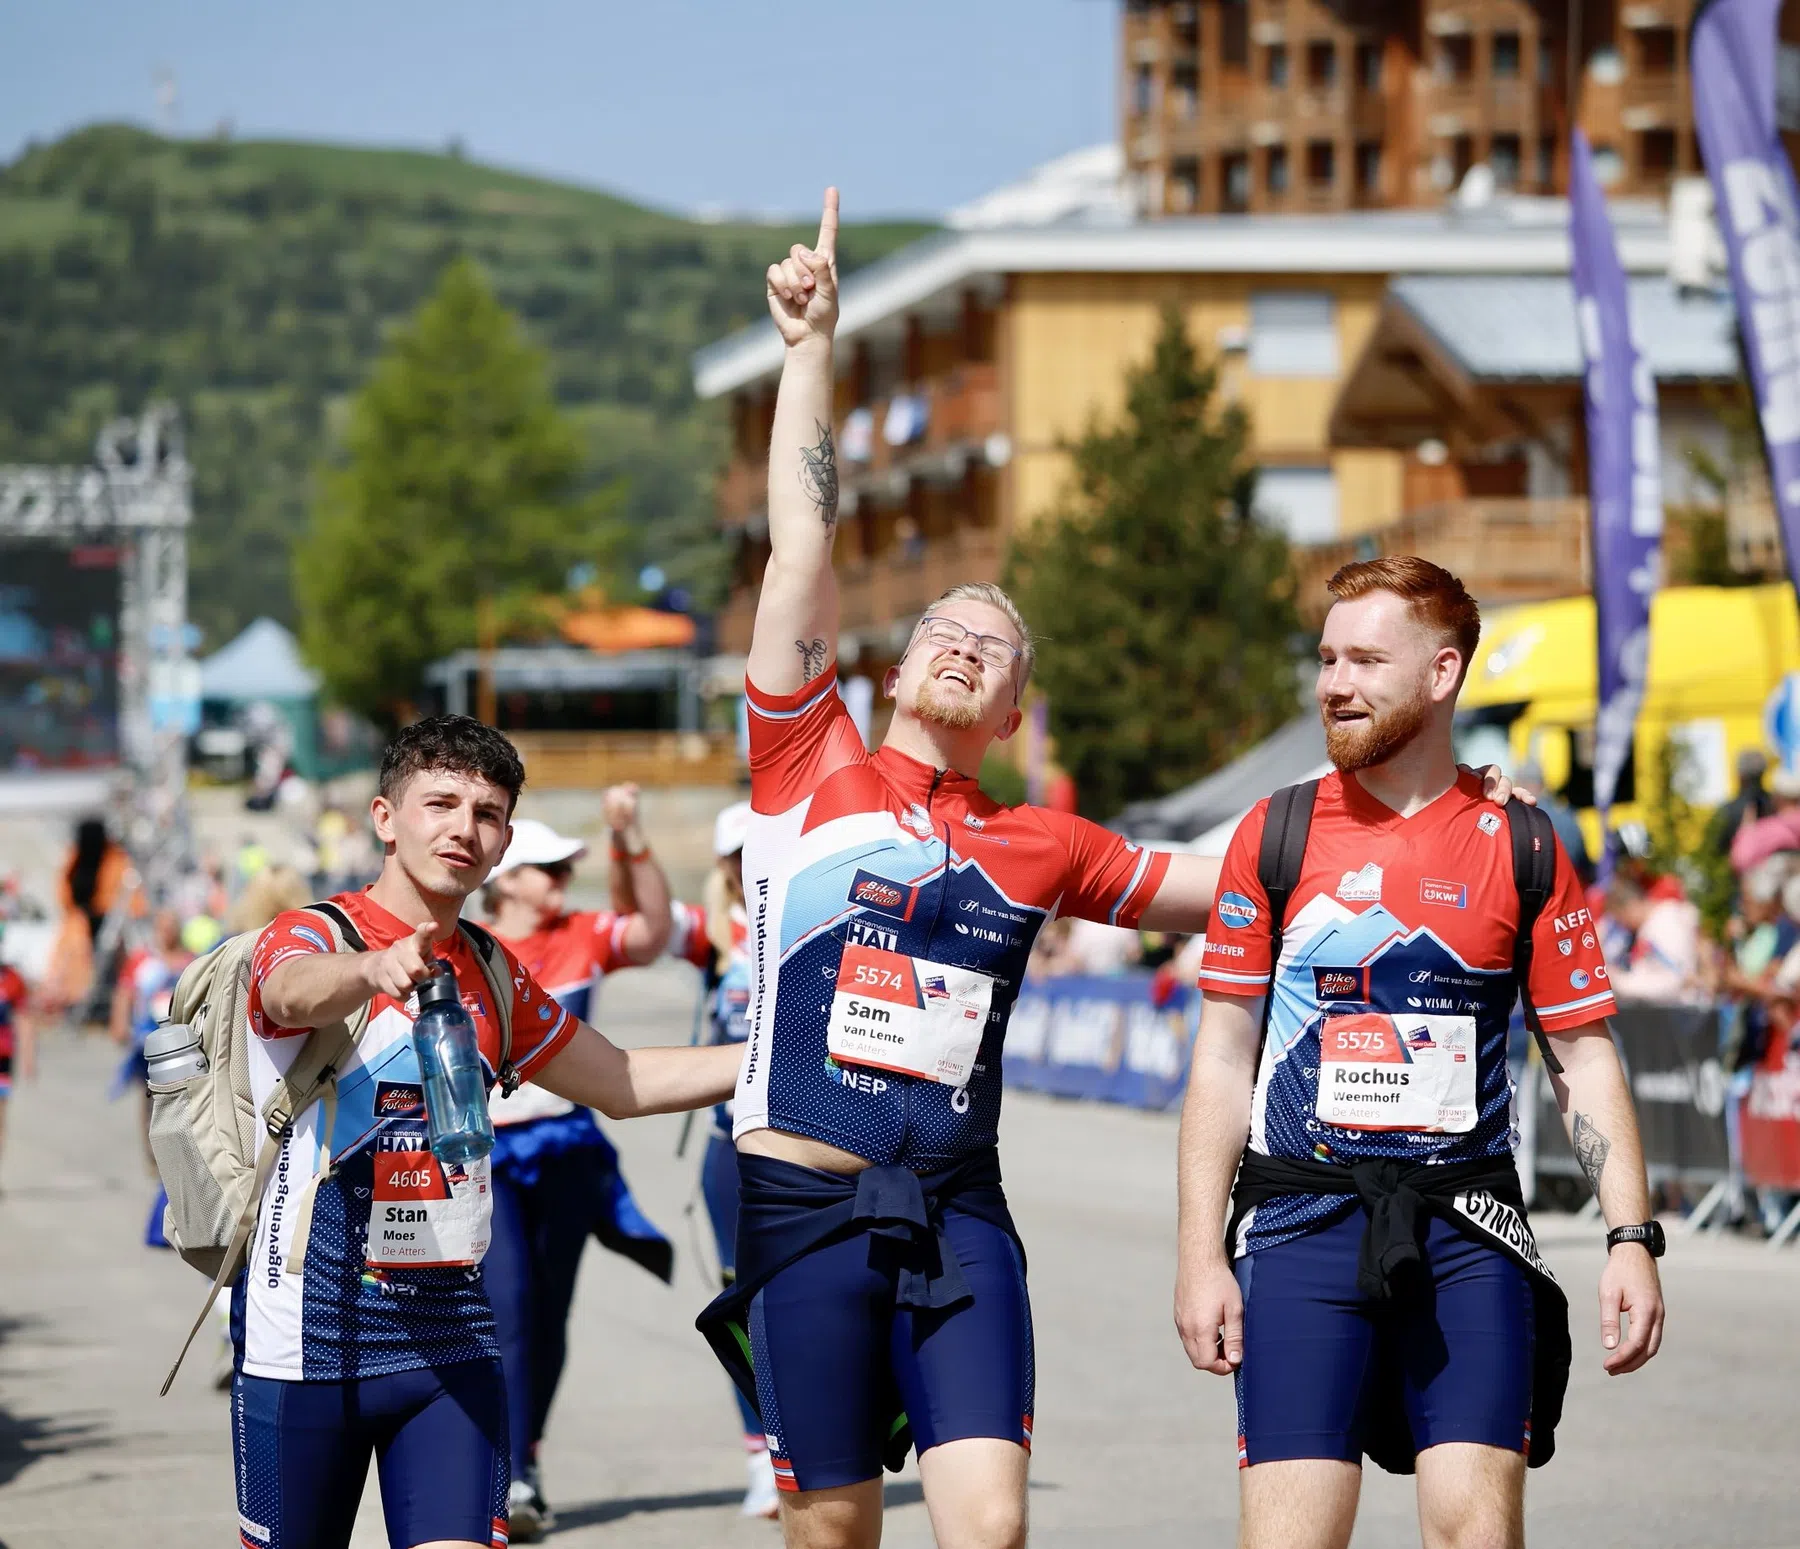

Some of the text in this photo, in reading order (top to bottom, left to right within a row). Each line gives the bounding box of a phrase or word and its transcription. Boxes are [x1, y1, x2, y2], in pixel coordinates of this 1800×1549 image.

[866, 881, 897, 896] Bike
[1338, 889, 1352, 898] Alpe
[1425, 882, 1442, 890] Samen
[1436, 892, 1459, 902] KWF
[982, 907, 996, 916] Hart
[849, 914, 899, 935] Evenementen
[973, 927, 1003, 943] VISMA
[747, 877, 769, 1084] opgevenisgeenoptie.nl
[854, 965, 903, 990] 5574
[1325, 973, 1352, 982] Bike
[1434, 975, 1449, 983] Hart
[1321, 980, 1355, 997] Totaal
[1425, 998, 1453, 1009] VISMA
[847, 1001, 890, 1023] Sam
[844, 1025, 905, 1045] van Lente
[1337, 1032, 1385, 1050] 5575
[841, 1039, 887, 1056] De Atters
[1335, 1068, 1410, 1085] Rochus
[389, 1090, 416, 1099] Bike
[1334, 1092, 1401, 1103] Weemhoff
[1333, 1108, 1380, 1118] De Atters
[388, 1170, 431, 1188] 4605
[385, 1207, 427, 1222] Stan
[384, 1230, 415, 1240] Moes
[382, 1247, 426, 1256] De Atters
